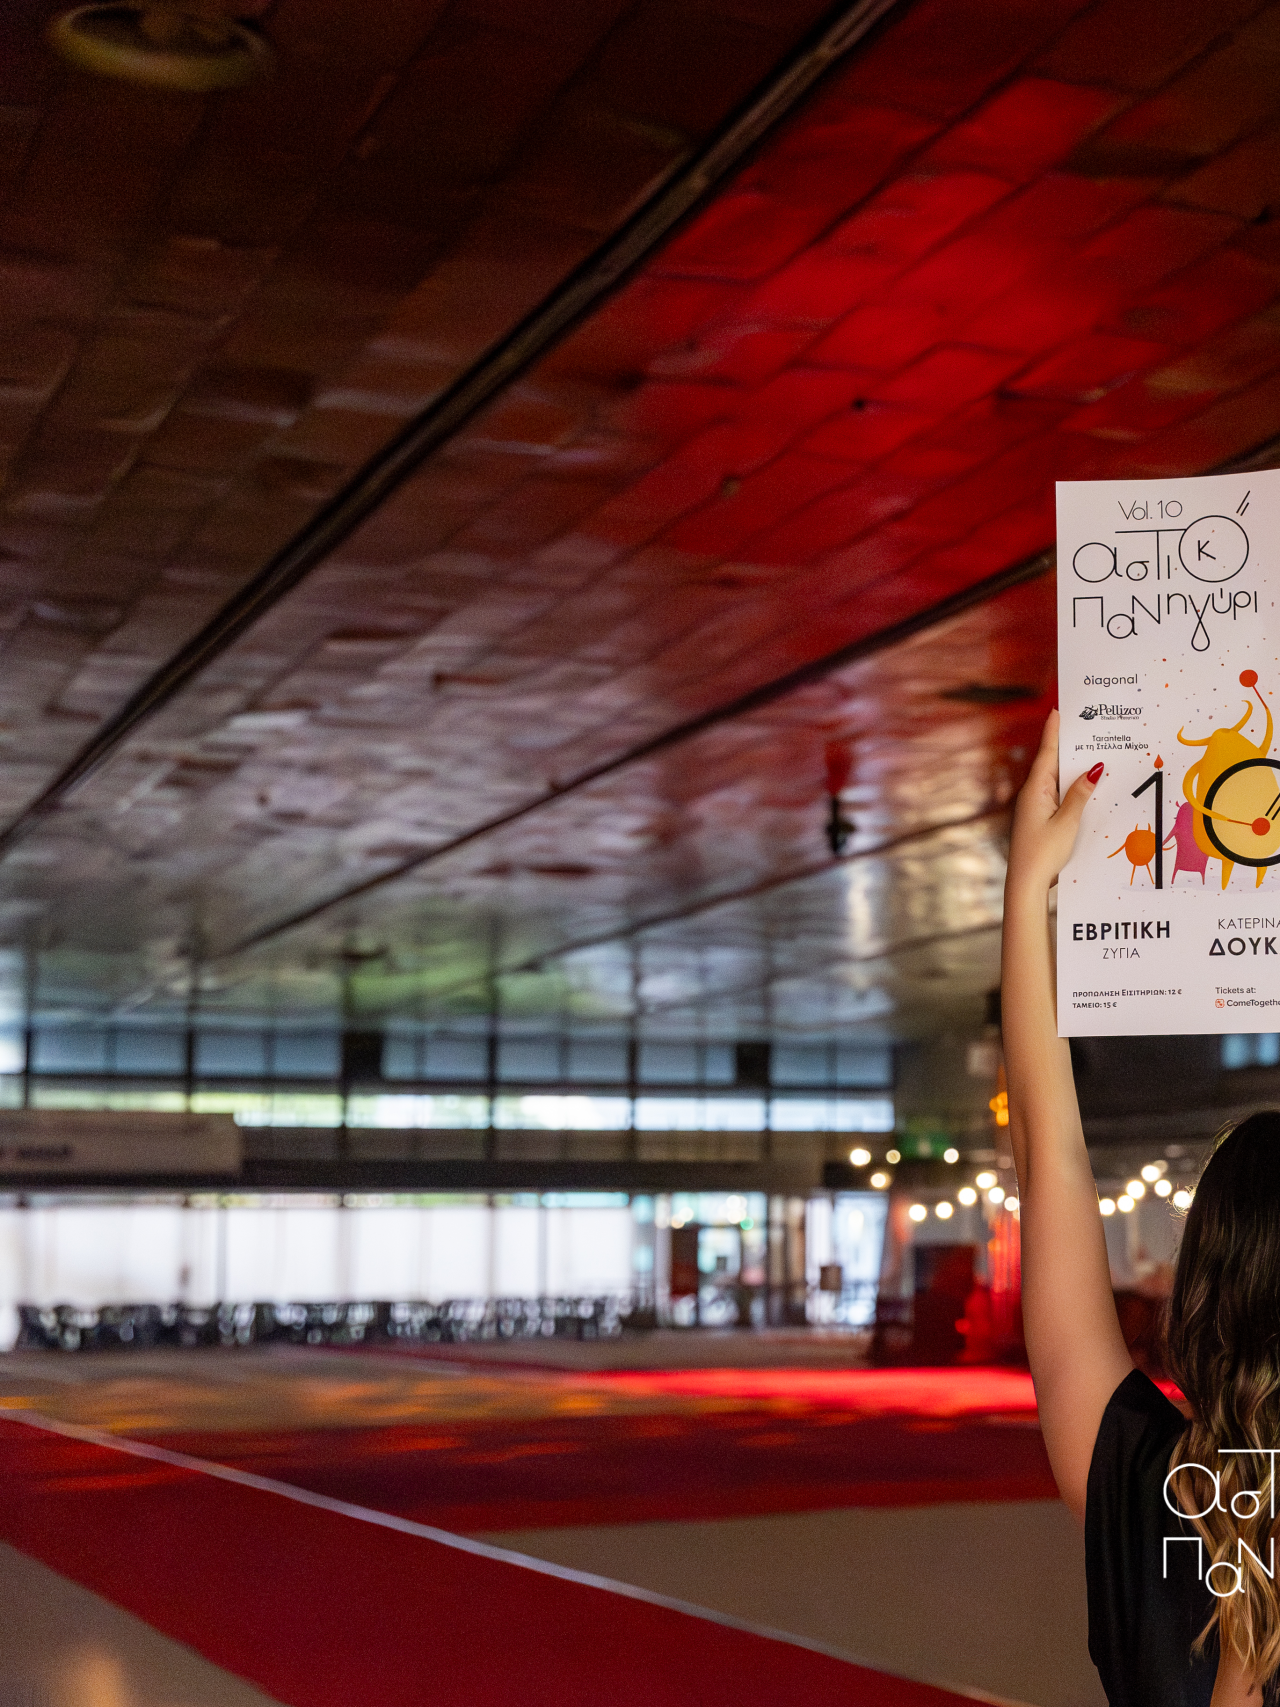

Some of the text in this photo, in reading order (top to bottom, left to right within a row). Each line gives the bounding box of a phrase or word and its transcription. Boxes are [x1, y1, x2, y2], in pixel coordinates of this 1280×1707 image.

[1118, 500, 1183, 520] Vol. 10
[1083, 673, 1138, 688] diagonal
[1098, 703, 1142, 716] Pellizco
[1096, 742, 1123, 750] Στέλλα
[1072, 920, 1170, 941] ΕΒΡΙΤΙΚΗ
[1102, 947, 1141, 960] ΖΥΓΙΑ
[1072, 990, 1120, 998] ΠΡΟΠΩΛΗΣΗ
